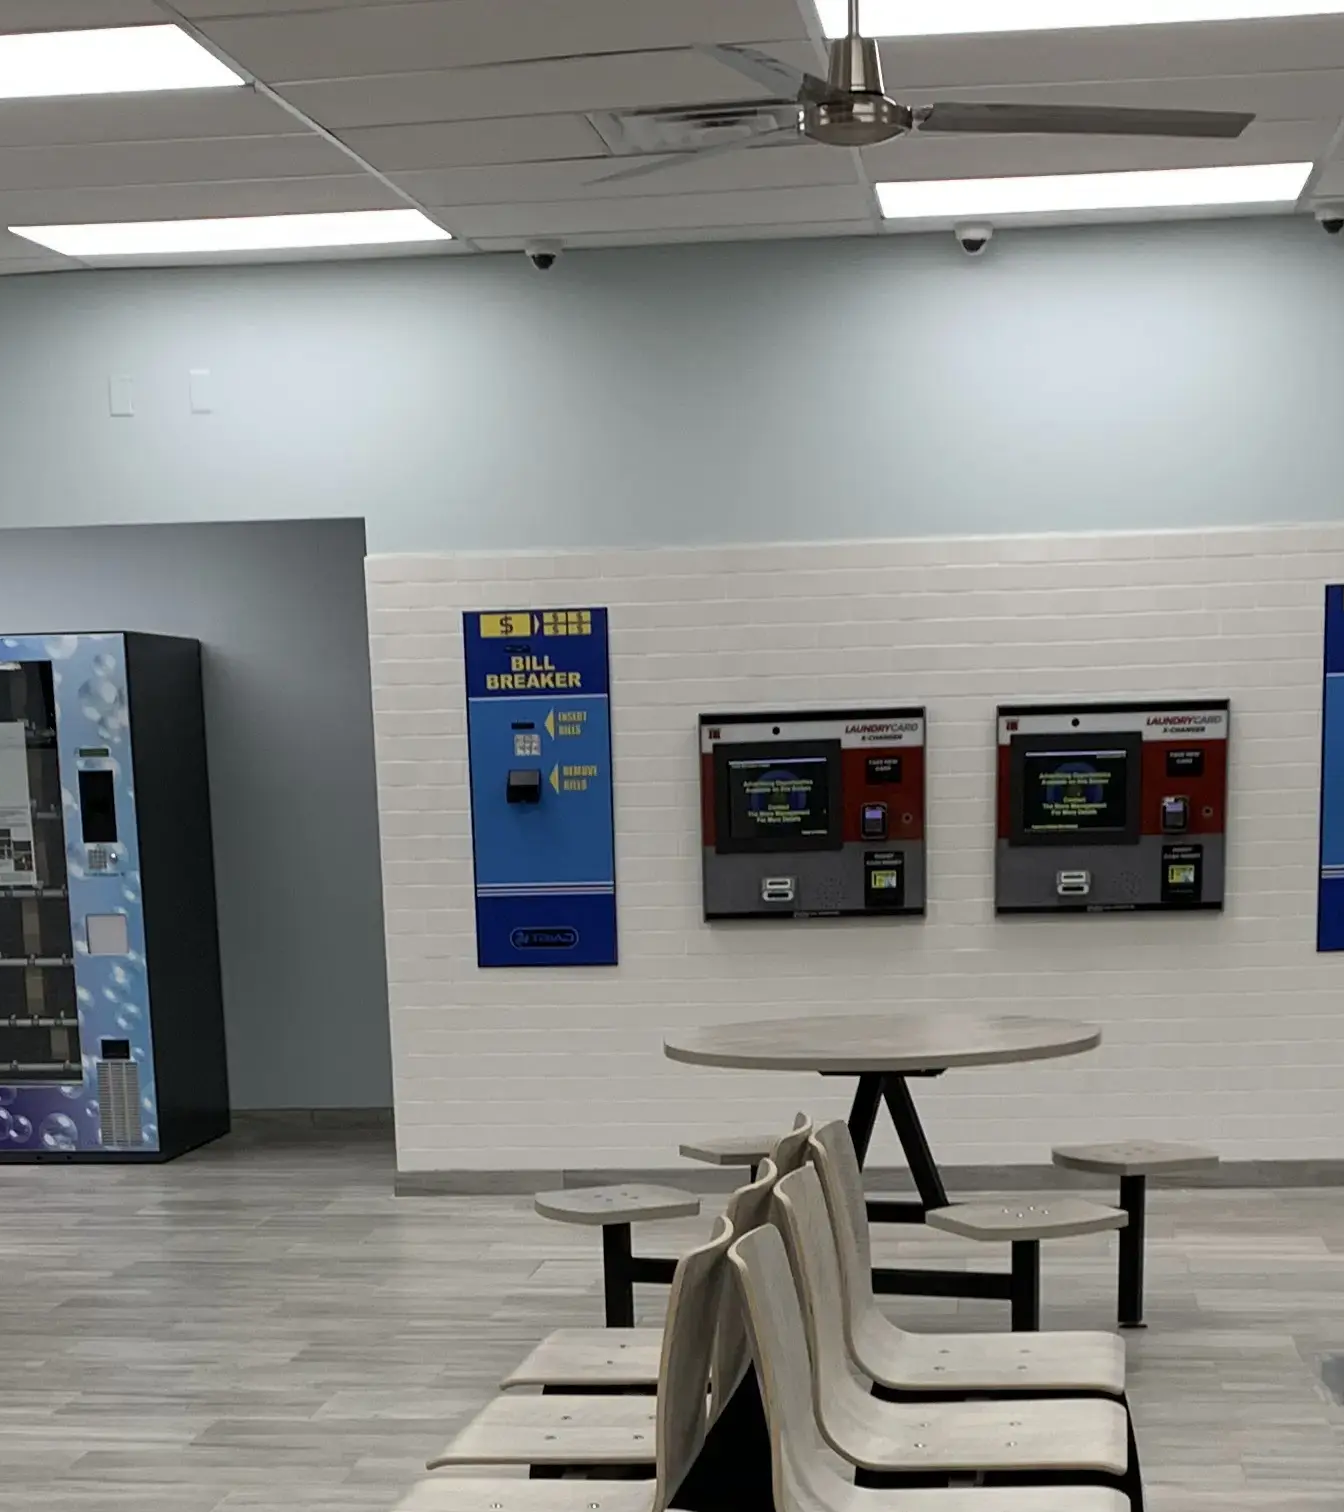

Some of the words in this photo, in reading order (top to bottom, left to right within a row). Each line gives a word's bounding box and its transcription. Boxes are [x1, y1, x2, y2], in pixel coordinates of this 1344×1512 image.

[499, 615, 514, 635] $
[510, 655, 555, 672] BILL
[485, 672, 582, 690] BREAKER
[558, 710, 587, 722] INSERT
[1145, 715, 1222, 726] LAUNDRYCARD
[558, 724, 581, 736] BILLS
[844, 723, 918, 734] LAUNDRYCARD
